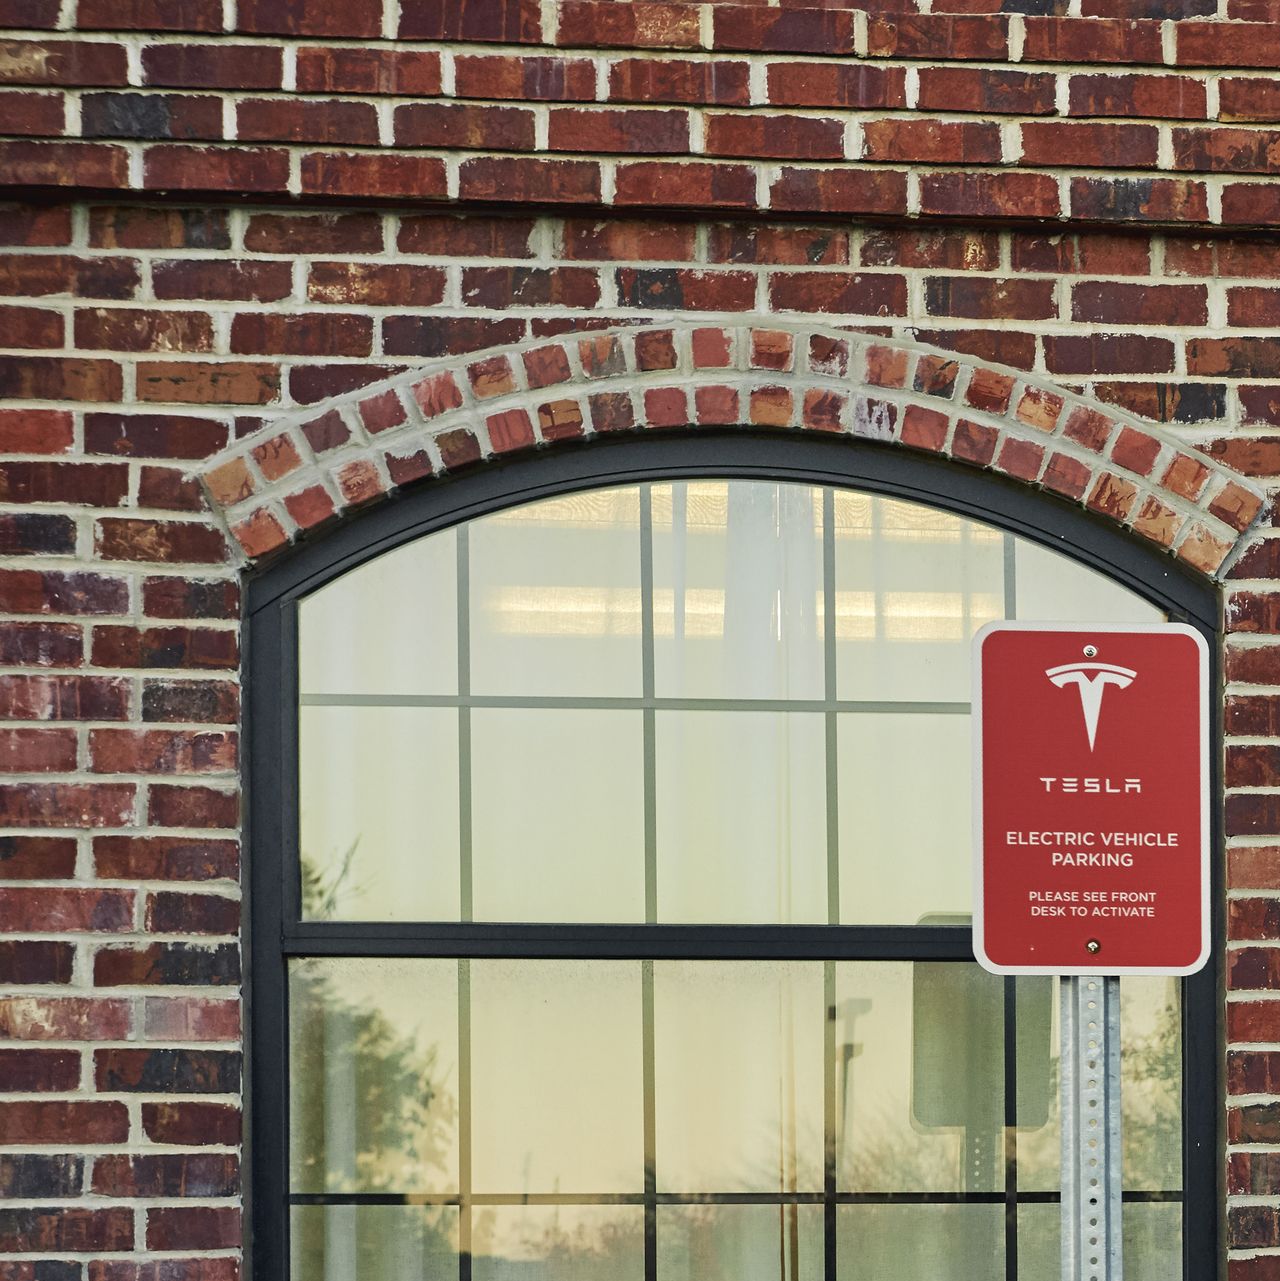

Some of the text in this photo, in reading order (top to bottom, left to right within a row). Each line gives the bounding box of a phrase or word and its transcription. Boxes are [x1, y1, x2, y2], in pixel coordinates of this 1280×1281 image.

[1039, 777, 1142, 793] TESLA
[1006, 831, 1179, 847] ELECTRIC VEHICLE
[1051, 852, 1134, 867] PARKING
[1028, 891, 1157, 902] PLEASE SEE FRONT
[1030, 905, 1155, 917] DESK TO ACTIVATE
